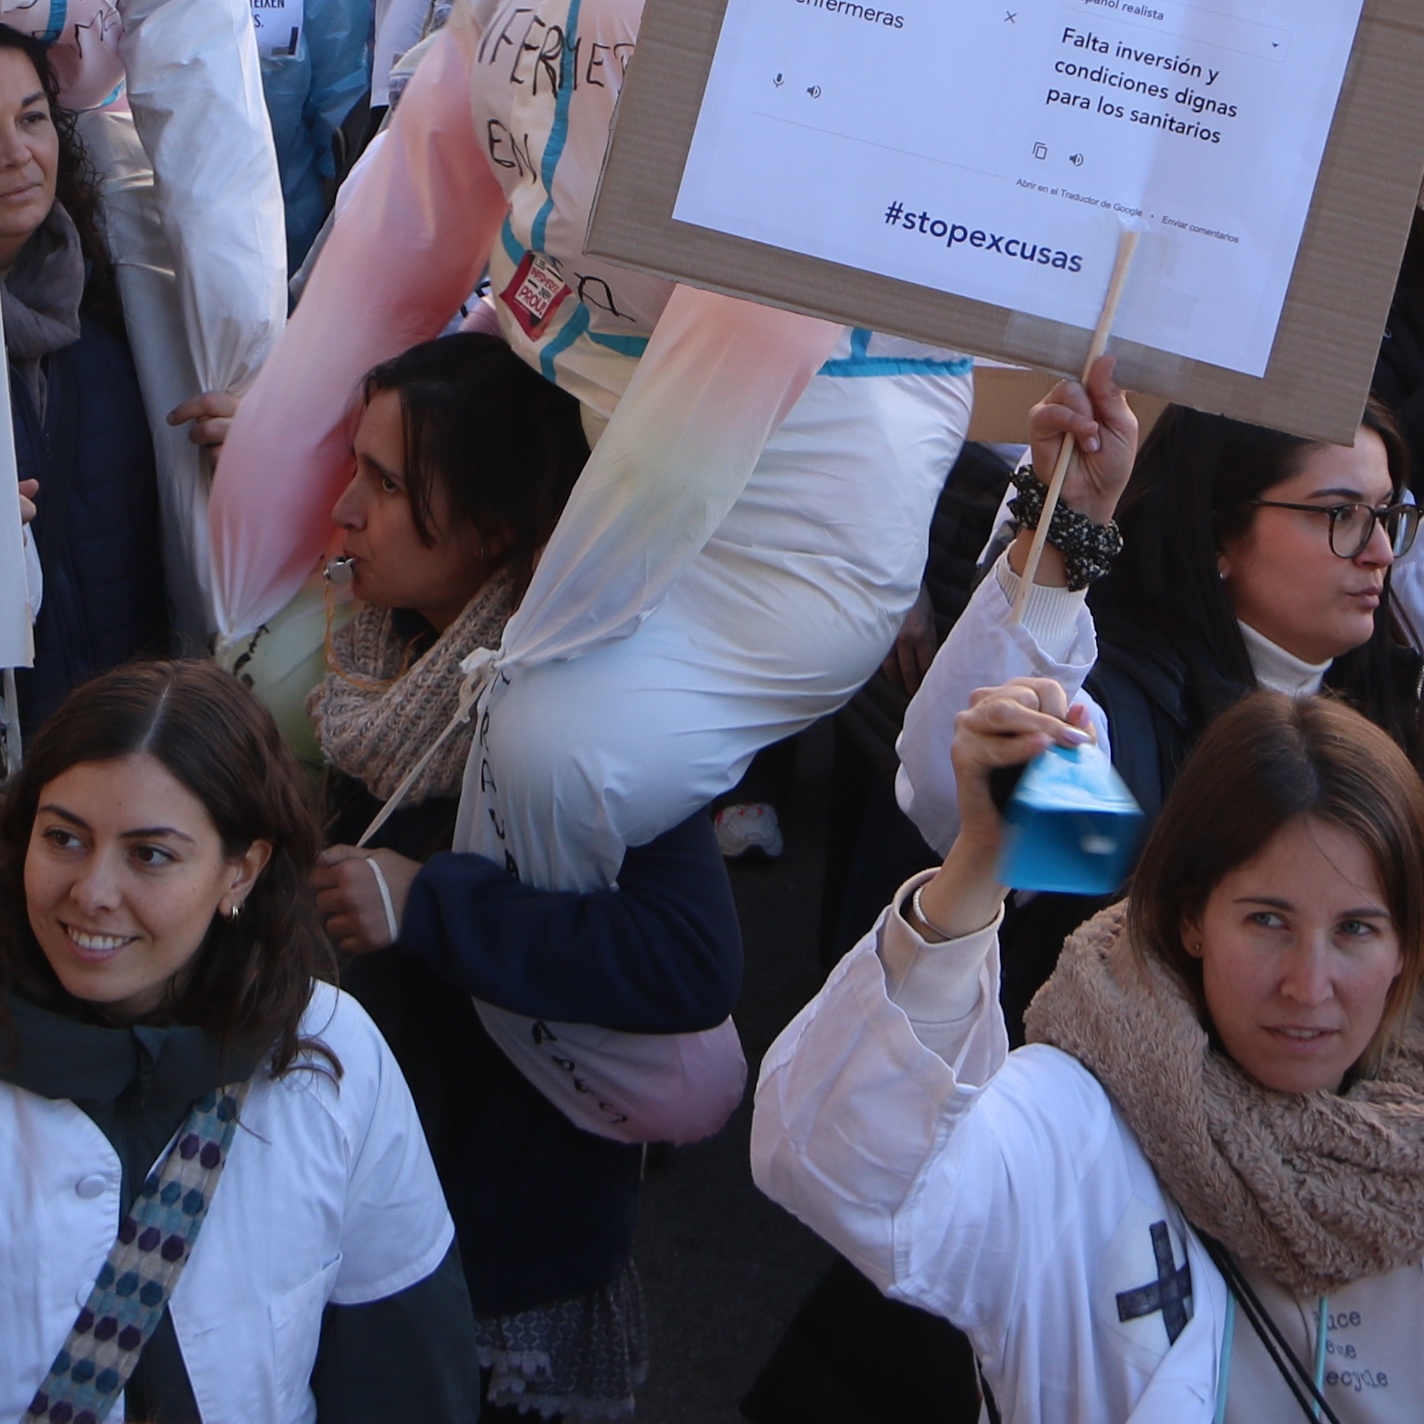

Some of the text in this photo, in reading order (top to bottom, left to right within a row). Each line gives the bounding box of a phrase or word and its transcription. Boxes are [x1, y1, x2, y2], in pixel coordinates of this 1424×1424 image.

[1053, 55, 1239, 123] condiciones dignas
[1062, 26, 1221, 88] Falta inversión y
[1046, 84, 1222, 145] para los sanitarios
[883, 200, 1084, 275] #stopexcusas
[1016, 178, 1240, 245] Abrir en el Traductor de Google Enviar comentarios
